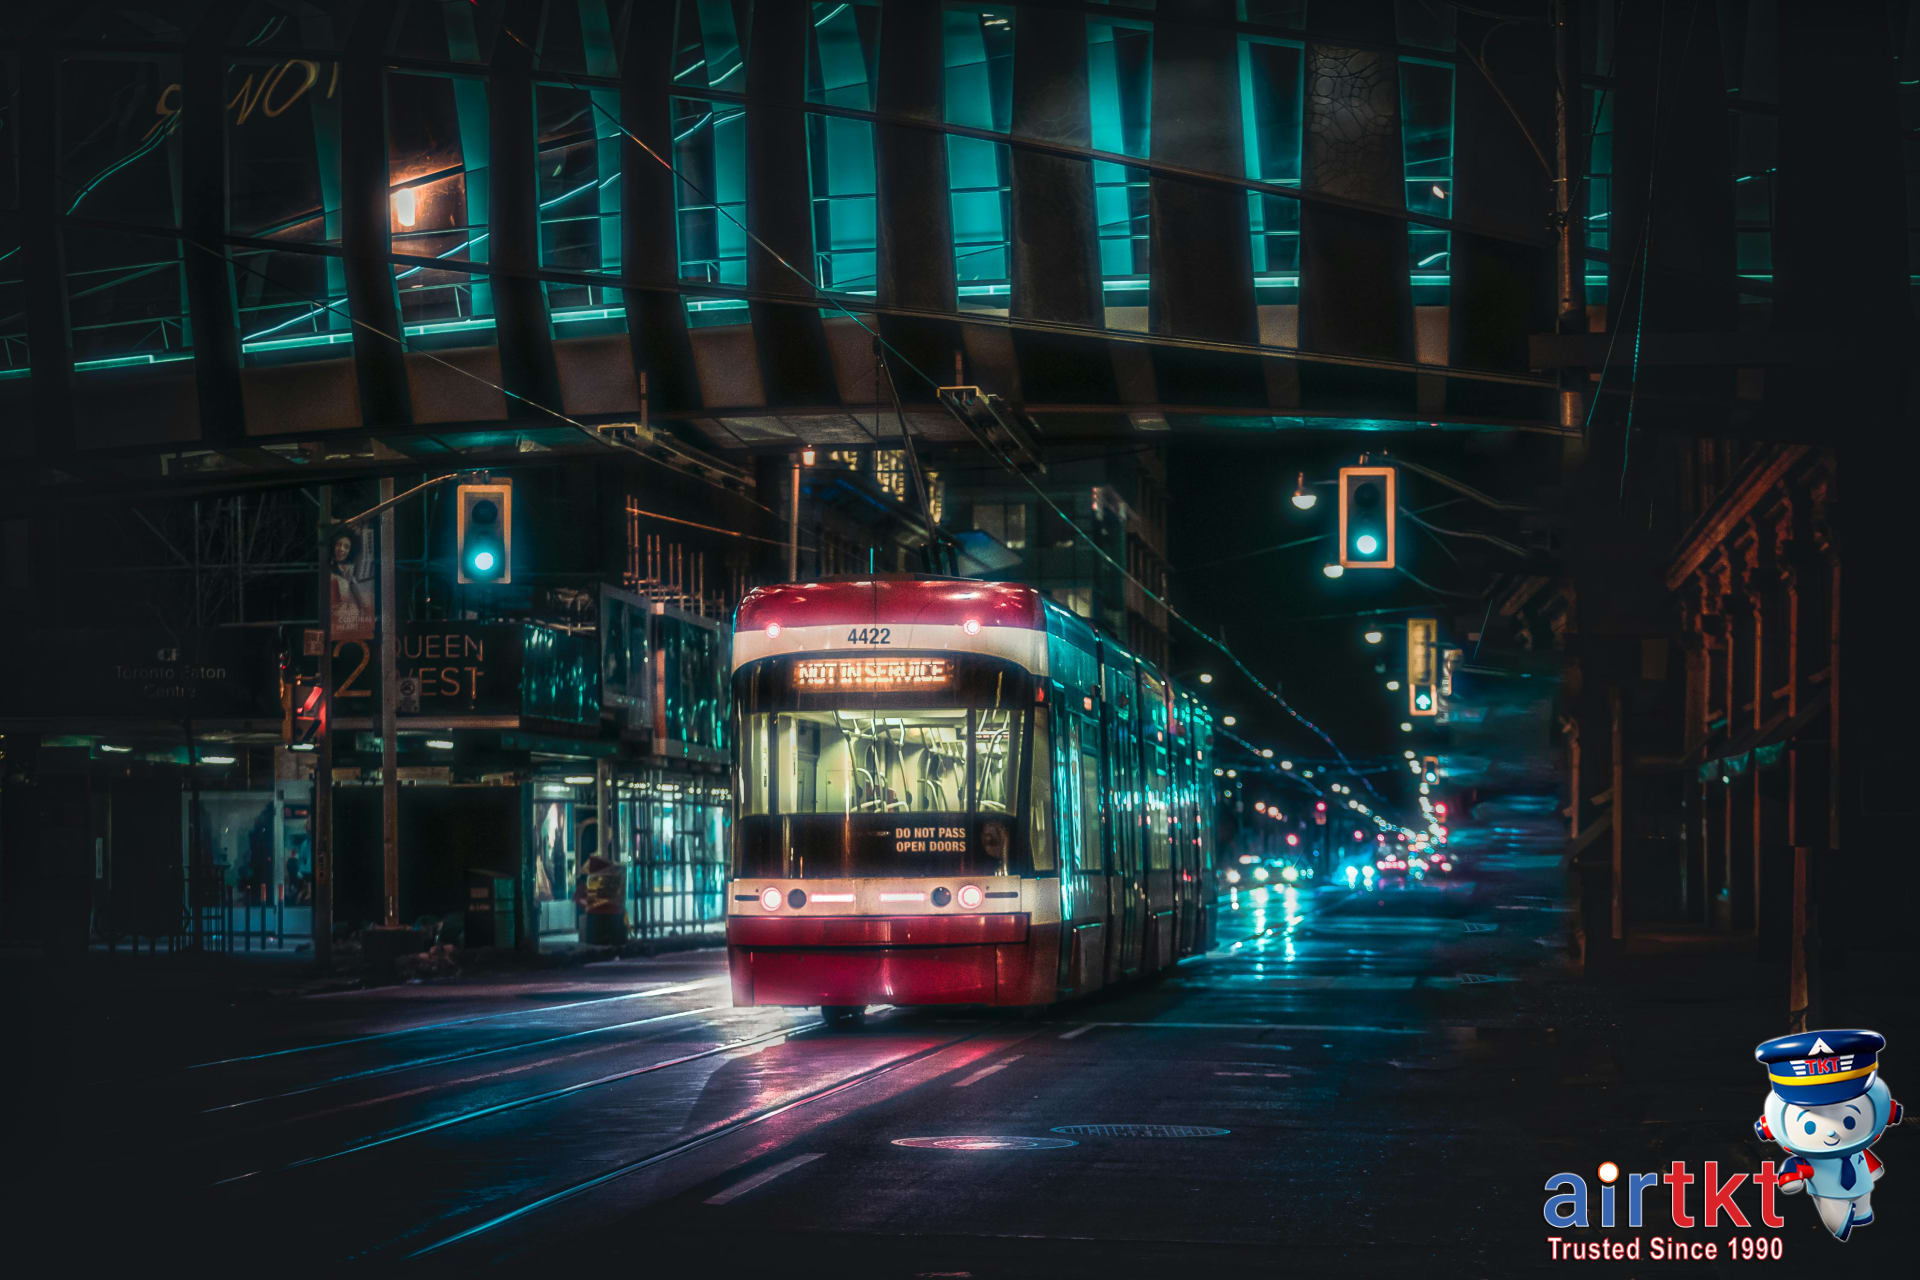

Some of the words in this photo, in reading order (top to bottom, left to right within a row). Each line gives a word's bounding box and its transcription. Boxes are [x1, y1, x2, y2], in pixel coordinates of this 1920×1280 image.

[395, 633, 484, 662] UEEN
[847, 628, 891, 645] 4422
[332, 639, 373, 698] 2
[799, 662, 836, 684] NOT
[840, 662, 864, 683] IN
[865, 660, 946, 683] SERVICE
[397, 665, 484, 700] EST
[895, 827, 911, 838] DO
[914, 827, 936, 838] NOT
[938, 827, 967, 838] PASS
[895, 841, 926, 852] OPEN
[929, 841, 967, 852] DOORS
